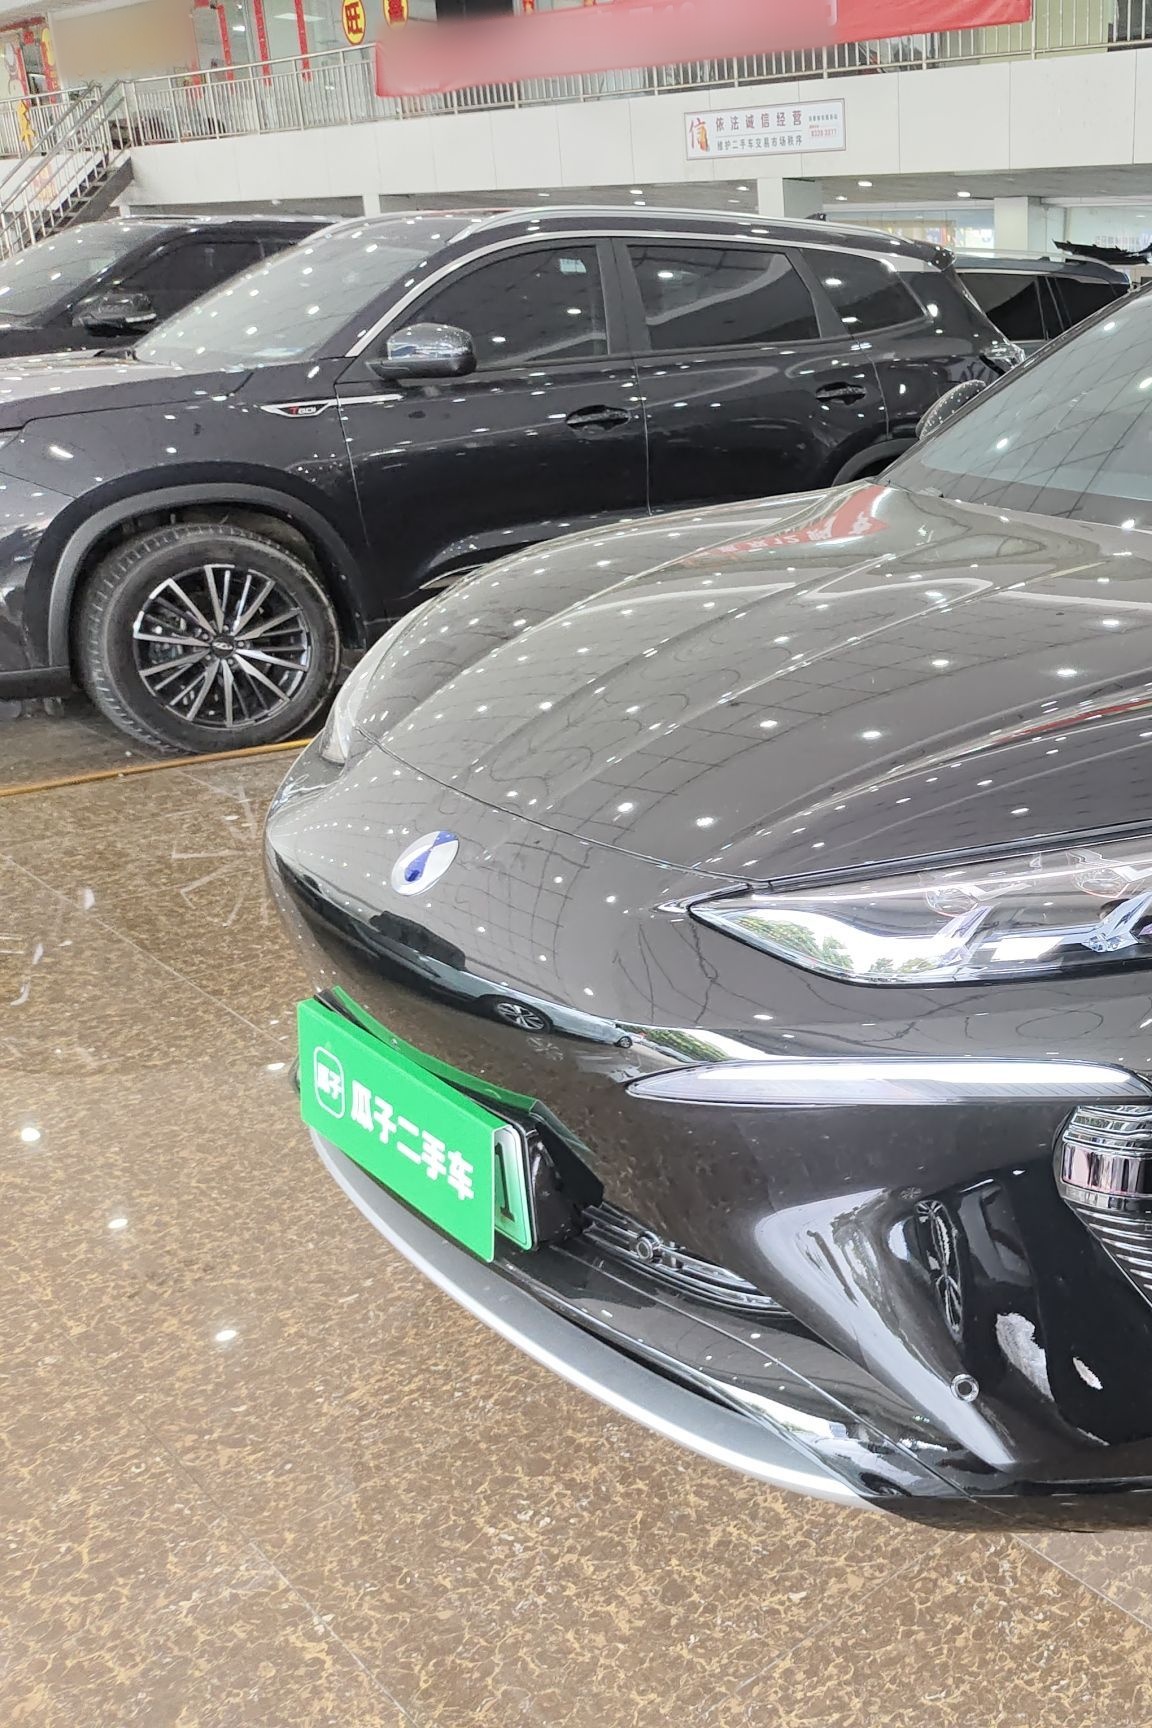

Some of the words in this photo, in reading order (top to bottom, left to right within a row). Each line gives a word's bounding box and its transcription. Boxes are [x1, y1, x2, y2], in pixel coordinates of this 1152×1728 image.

[345, 2, 363, 34] 旺
[715, 110, 802, 132] 依法诚信经营
[717, 134, 803, 151] 维护二手车交易市场秩序
[351, 1079, 475, 1201] 瓜子二手车
